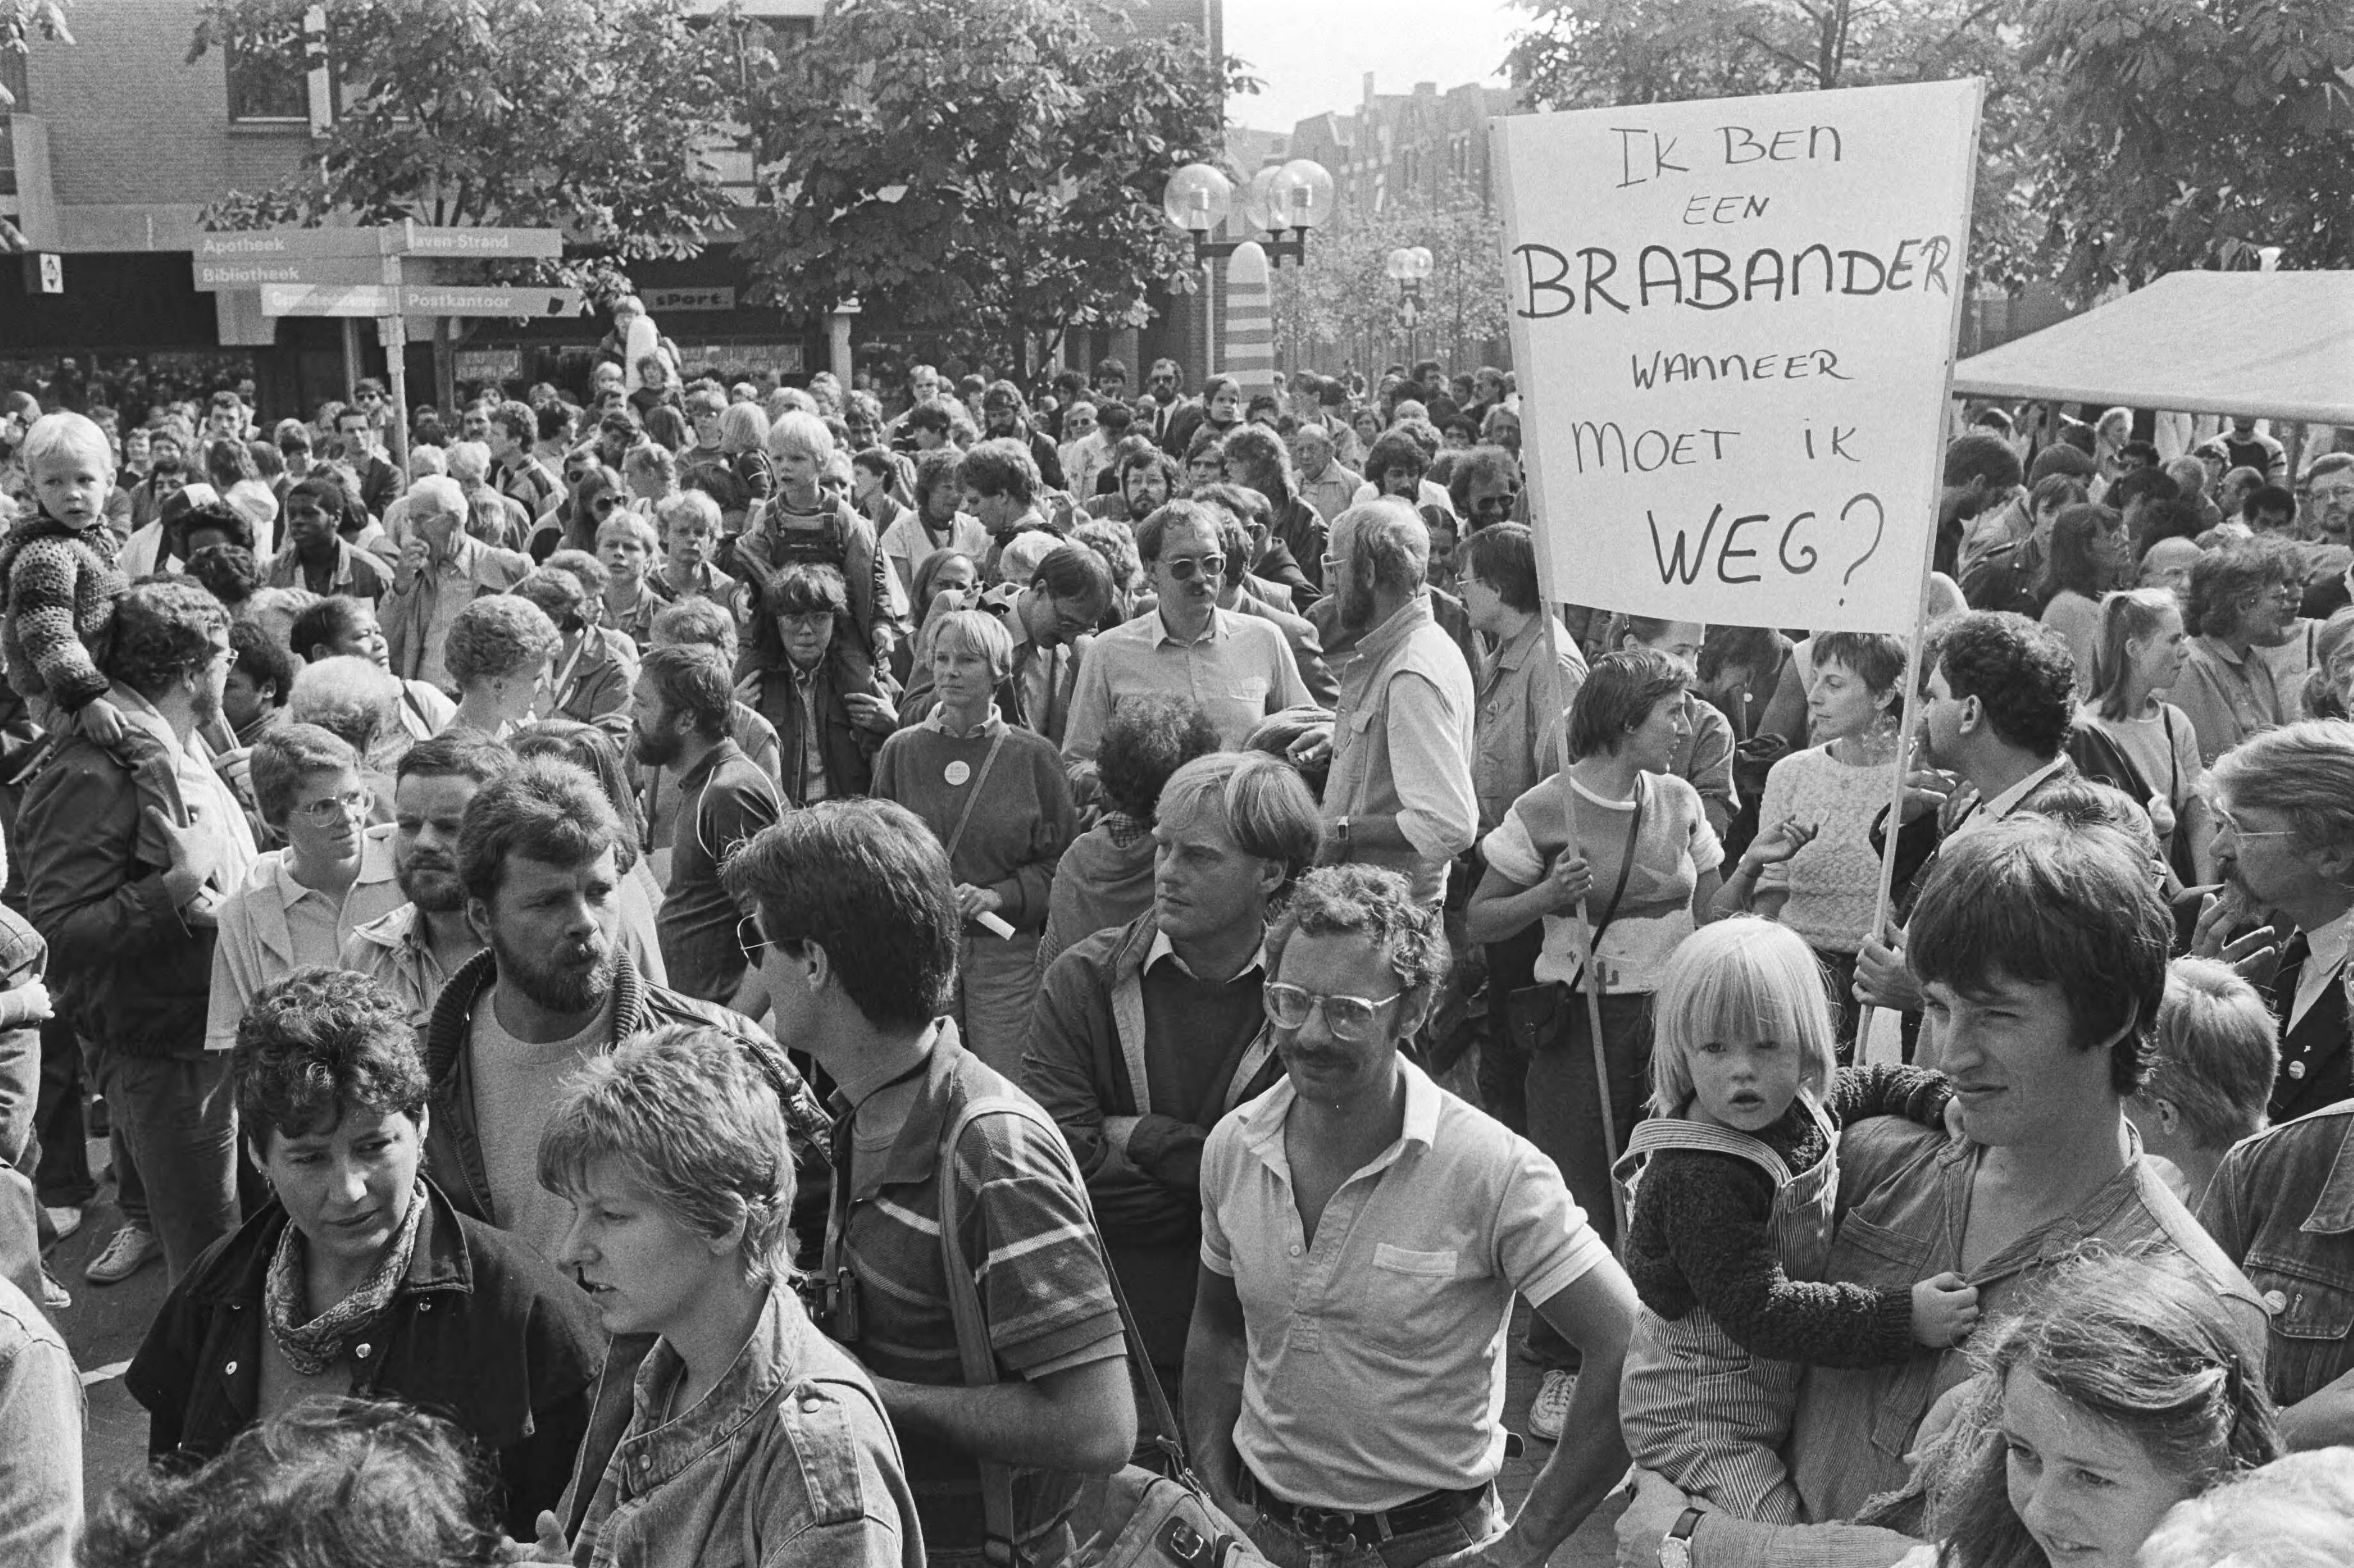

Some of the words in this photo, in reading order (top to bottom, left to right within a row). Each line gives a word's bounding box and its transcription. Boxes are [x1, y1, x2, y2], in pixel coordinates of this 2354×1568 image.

[1611, 128, 1690, 188] IK
[1683, 195, 1770, 225] EEN
[203, 238, 284, 252] Apotheek
[413, 234, 509, 249] aven-Strand
[202, 267, 299, 282] Bibliotheek
[1512, 235, 1950, 319] BRABANDER
[409, 293, 511, 307] Postkantoor
[1632, 349, 1852, 390] WANNEER
[1572, 421, 1740, 474] MOET
